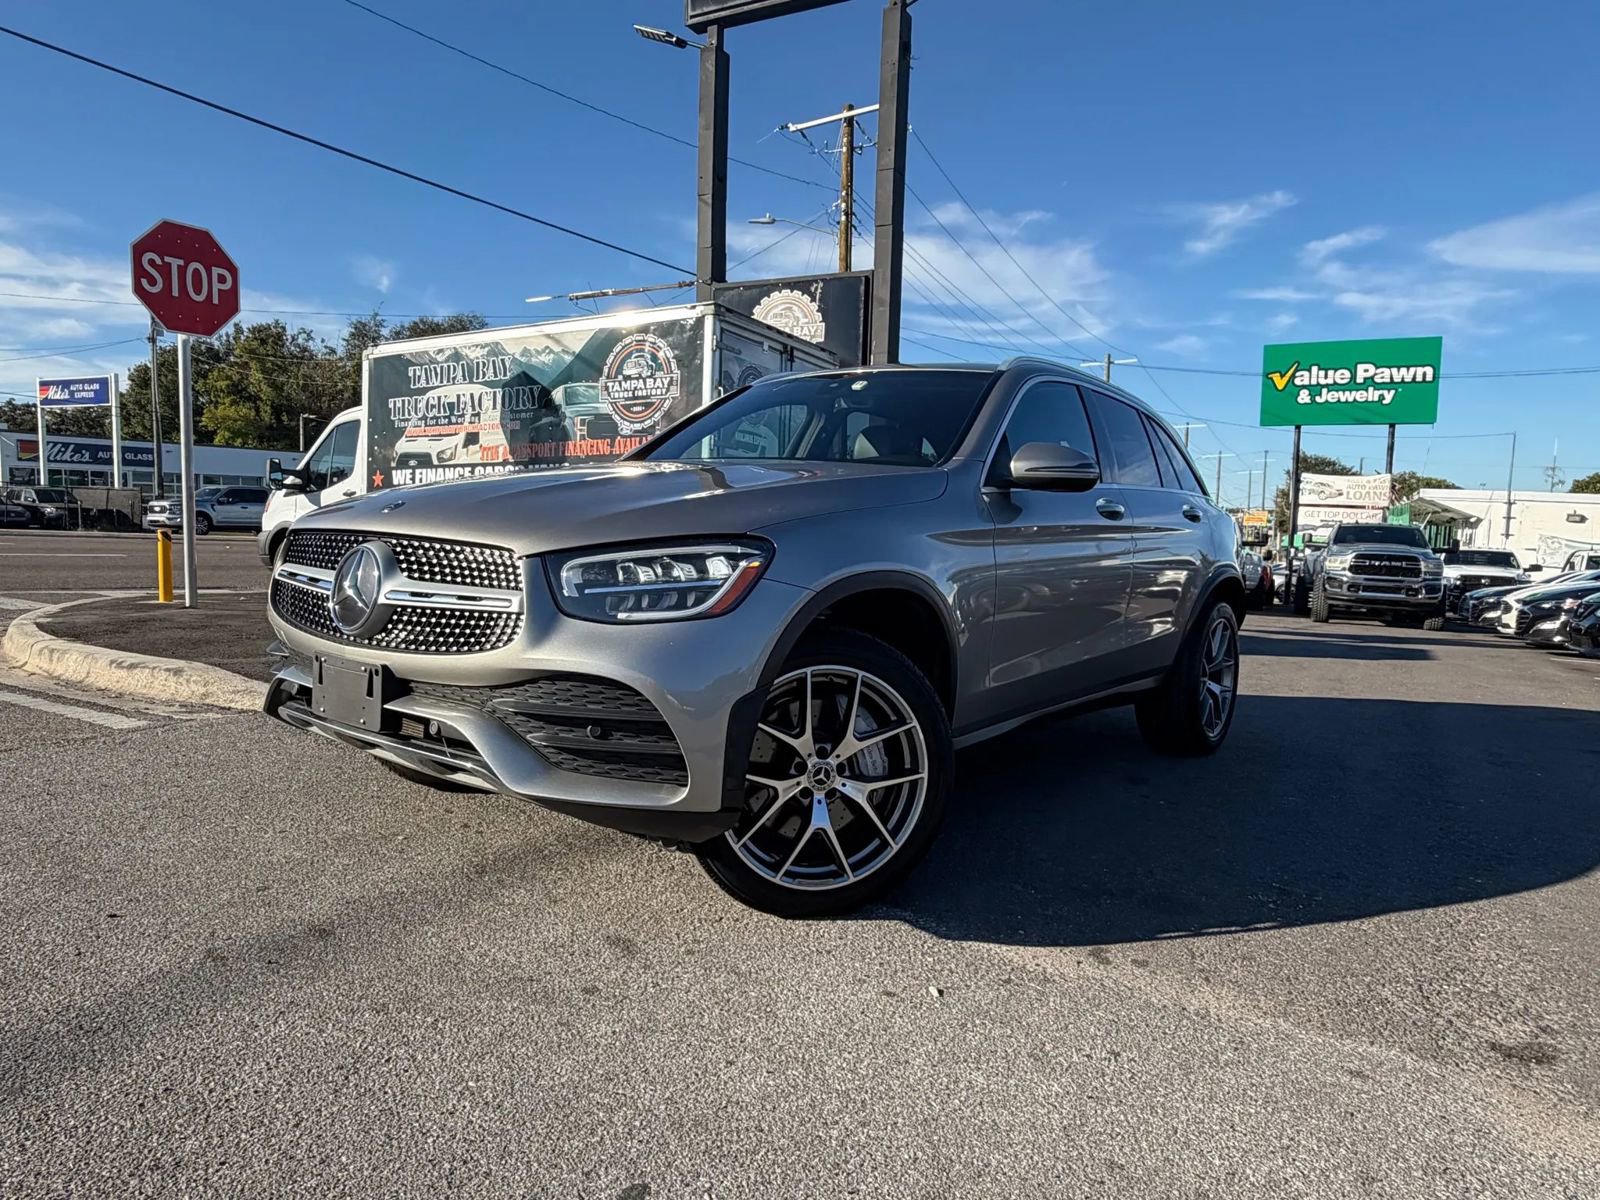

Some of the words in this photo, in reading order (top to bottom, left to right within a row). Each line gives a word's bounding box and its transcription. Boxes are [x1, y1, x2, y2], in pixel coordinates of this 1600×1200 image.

[140, 251, 233, 305] STOP
[408, 360, 469, 389] TAMPA
[474, 355, 513, 382] BAY
[1268, 362, 1350, 390] Value
[1356, 363, 1433, 384] Pawn
[46, 385, 70, 400] Mike's
[607, 380, 644, 392] TAMPA
[646, 378, 670, 388] BAY
[388, 393, 451, 420] TRUCK
[454, 385, 541, 415] FACTORY
[1297, 388, 1312, 404] &
[1315, 387, 1396, 404] Jewelry
[427, 417, 437, 425] for
[438, 416, 448, 424] the
[559, 438, 611, 457] FINANCING
[613, 435, 653, 455] AVAILA
[97, 451, 114, 459] AUT
[125, 453, 153, 461] GLASS
[392, 469, 412, 486] WE
[414, 466, 471, 484] FINANCE
[1346, 491, 1390, 501] LOANS
